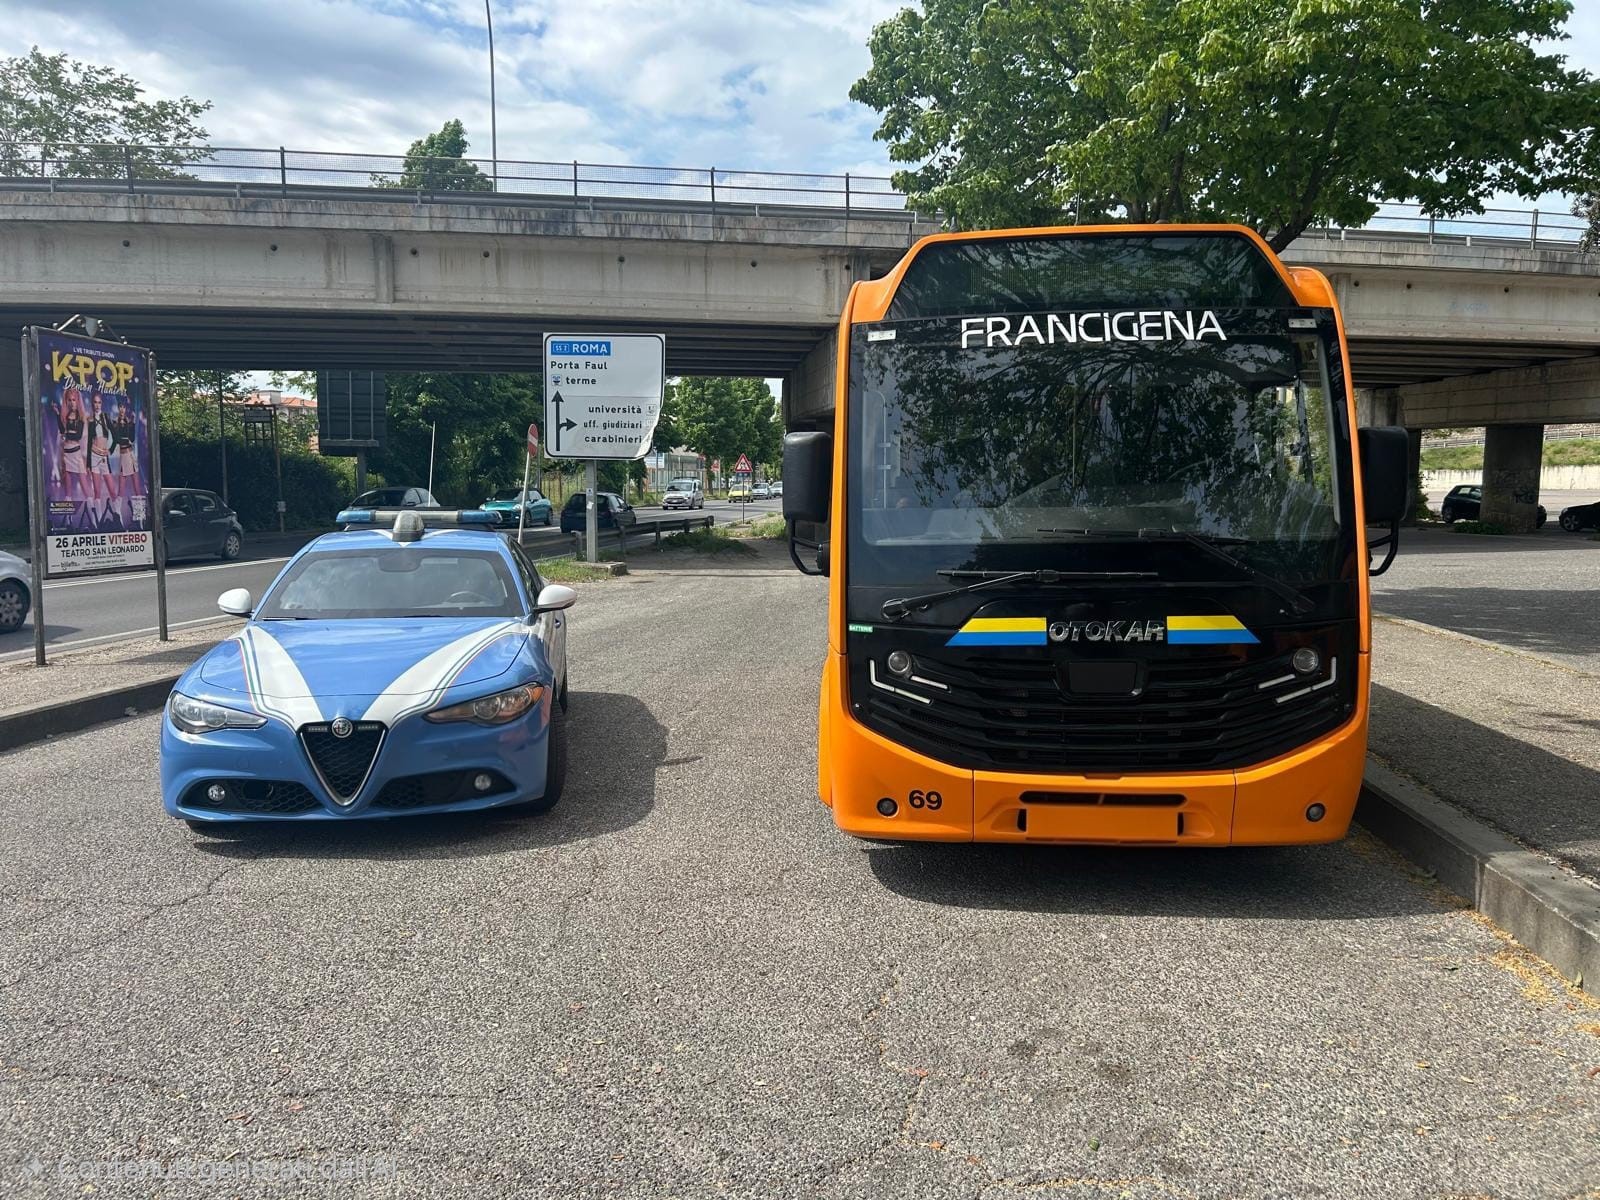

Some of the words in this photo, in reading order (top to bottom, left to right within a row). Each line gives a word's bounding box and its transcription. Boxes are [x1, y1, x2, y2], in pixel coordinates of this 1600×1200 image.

[572, 343, 608, 353] ROMA
[550, 361, 580, 369] Porta
[584, 361, 608, 370] Faul
[565, 376, 597, 385] terme
[588, 405, 642, 414] università
[583, 420, 599, 428] uff.
[602, 420, 642, 430] giudiziari
[584, 435, 642, 443] carabinieri
[56, 538, 68, 549] 26
[72, 536, 107, 547] APRILE
[108, 534, 147, 545] VITERBO
[61, 549, 91, 558] TEATRO
[92, 547, 107, 555] SAN
[108, 545, 145, 554] LEONARDO
[1048, 620, 1165, 642] OTOKAR
[908, 789, 943, 811] 69
